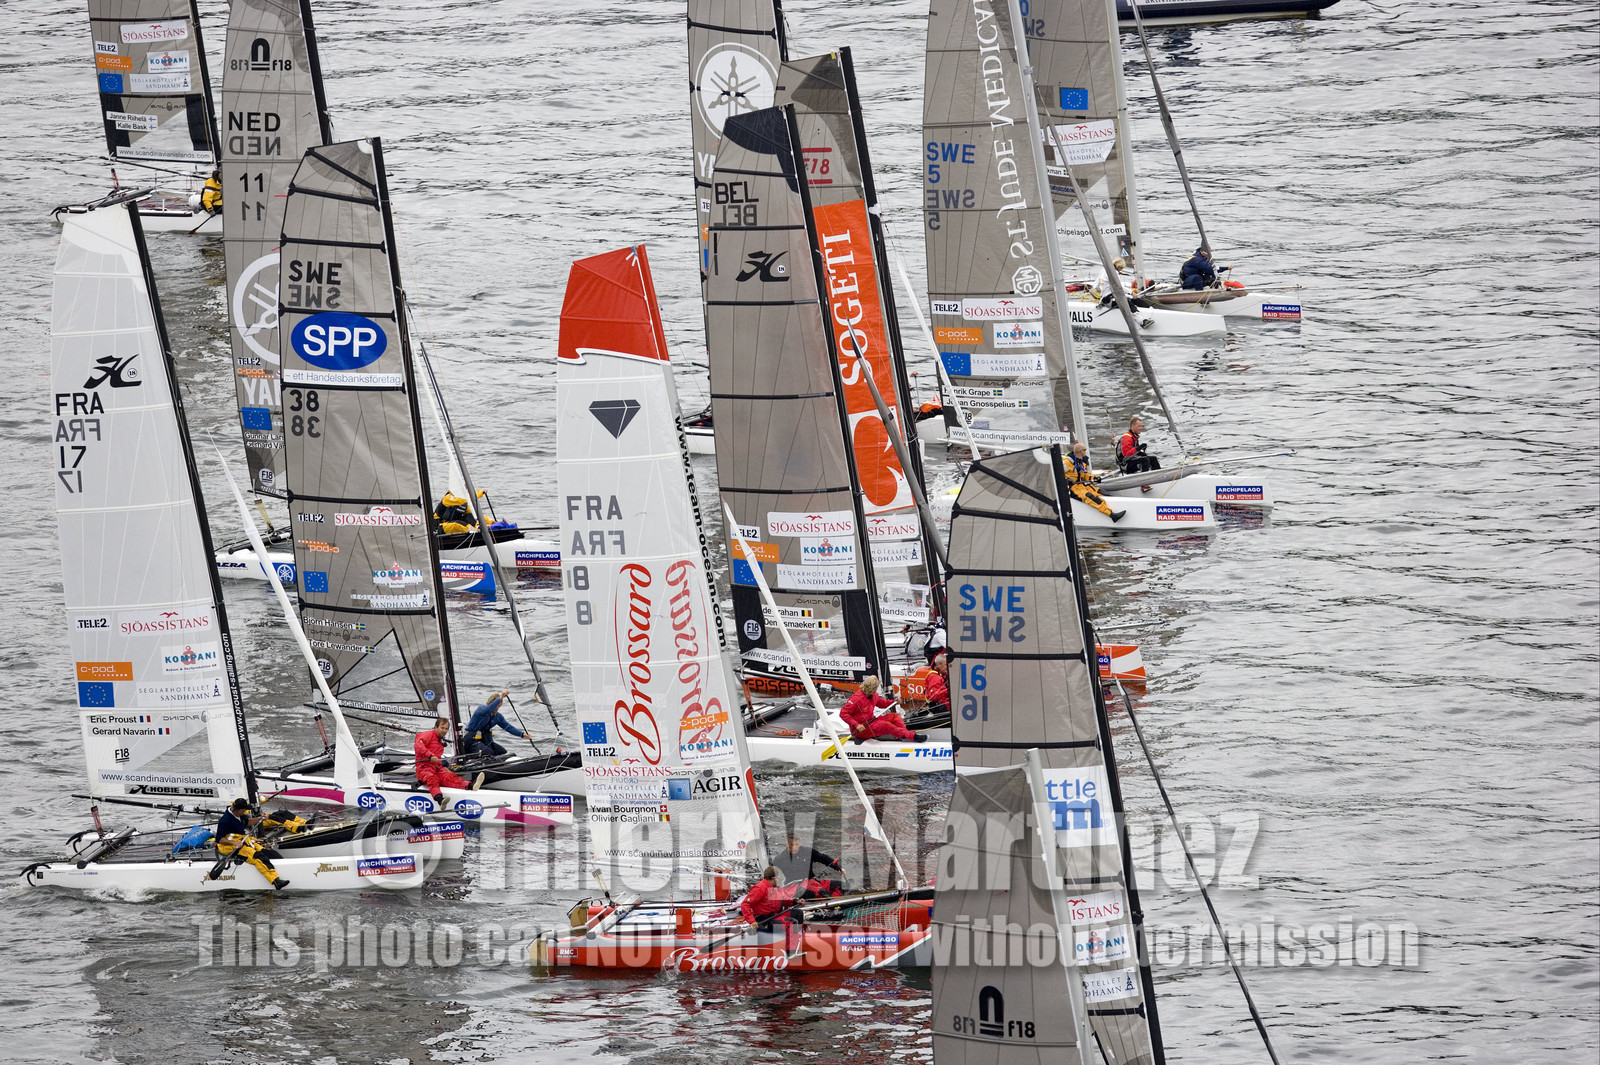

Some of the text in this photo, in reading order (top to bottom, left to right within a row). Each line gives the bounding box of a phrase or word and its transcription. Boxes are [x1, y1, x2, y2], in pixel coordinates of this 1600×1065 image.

[123, 29, 186, 42] SJÖASSISTANS
[97, 44, 116, 52] TELE2
[150, 57, 188, 65] KOMPANI
[229, 111, 281, 132] NED
[926, 142, 976, 164] SWE
[928, 165, 940, 184] 5
[714, 181, 759, 204] BEL
[288, 260, 343, 285] SWE
[822, 229, 875, 386] SOGETI
[934, 303, 957, 312] TELE2
[965, 305, 1040, 318] SJÖASSISTANS
[938, 330, 967, 339] c-pod
[997, 331, 1040, 339] KOMPANI
[303, 324, 377, 358] SPP
[293, 373, 401, 386] ett Handelsbanksföretag
[968, 389, 991, 399] Grape
[55, 392, 104, 416] FRA
[290, 389, 320, 412] 38
[60, 446, 86, 469] 17
[567, 495, 623, 521] FRA
[298, 514, 325, 523] TELE2
[336, 513, 420, 526] SJÖASSISTANS
[675, 415, 728, 649] www.team-ocean.com
[770, 519, 852, 534] SJÖASSISTANS
[803, 545, 852, 554] KOMPANI
[516, 554, 559, 562] ARCHIPELAGO
[373, 569, 422, 579] KOMPANI
[442, 565, 484, 574] ARCHIPELAGO
[442, 572, 457, 580] RAID
[370, 600, 418, 608] SANDHAMN
[959, 584, 1025, 613] SWE
[78, 618, 108, 629] TELE2
[121, 615, 209, 634] SJÖASSISTANS
[304, 616, 353, 629] Björn Hansen
[747, 622, 760, 632] F18
[326, 641, 363, 652] Lewander
[165, 651, 216, 664] KOMPANI
[81, 665, 114, 675] c-pod
[614, 563, 662, 766] Brossard
[961, 663, 987, 691] 16
[160, 692, 210, 702] SANDHAMN
[90, 715, 137, 725] Eric Proust
[680, 714, 715, 728] c-pod
[92, 727, 156, 736] Gerard Navarin
[680, 738, 733, 752] KOMPANI
[115, 748, 130, 759] F18
[588, 747, 616, 757] TELE2
[914, 747, 952, 758] TT-Lin
[585, 766, 672, 779] SJÖASSISTANS
[101, 774, 235, 786] www.scandinavianislands.com
[693, 775, 743, 795] AGIR
[150, 786, 213, 795] HOBIE TIGER
[609, 792, 657, 800] SANDHAMN
[361, 796, 384, 807] SPP
[408, 801, 432, 813] SPP
[457, 803, 482, 816] SPP
[522, 805, 541, 813] RAID
[590, 805, 657, 816] Yvan Bourgnon
[591, 814, 657, 826] Olivier Gagliani
[409, 824, 462, 834] ARCHIPELAGO
[410, 835, 430, 843] RAID
[604, 848, 742, 859] www.scandinavianislands.com
[359, 858, 413, 867] ARCHIPELAGO
[360, 868, 380, 876] RAID
[1076, 936, 1125, 953] OMPANI
[671, 947, 790, 972] Brossard
[1007, 1020, 1035, 1038] f18
